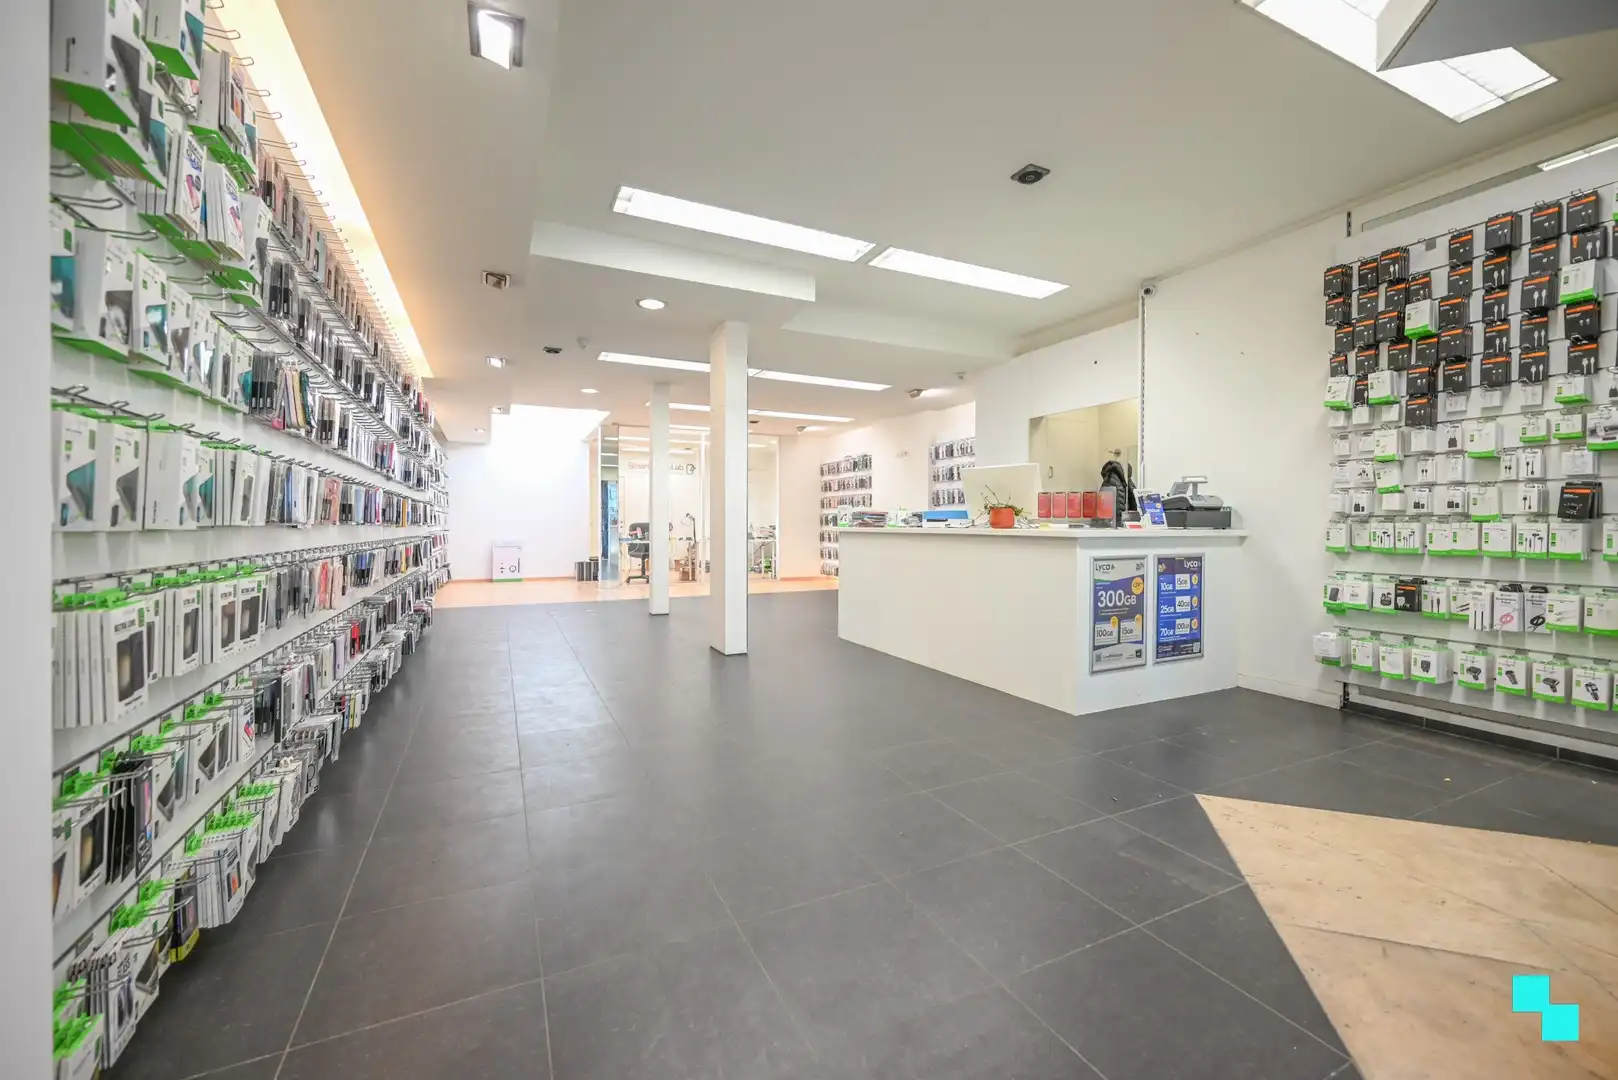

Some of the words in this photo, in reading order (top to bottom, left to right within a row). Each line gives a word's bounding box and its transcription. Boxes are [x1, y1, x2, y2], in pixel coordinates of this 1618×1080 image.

[1095, 563, 1111, 572] Lyca
[1184, 560, 1198, 570] Lyca
[1097, 589, 1137, 608] 300GB
[1096, 629, 1114, 638] 100GB
